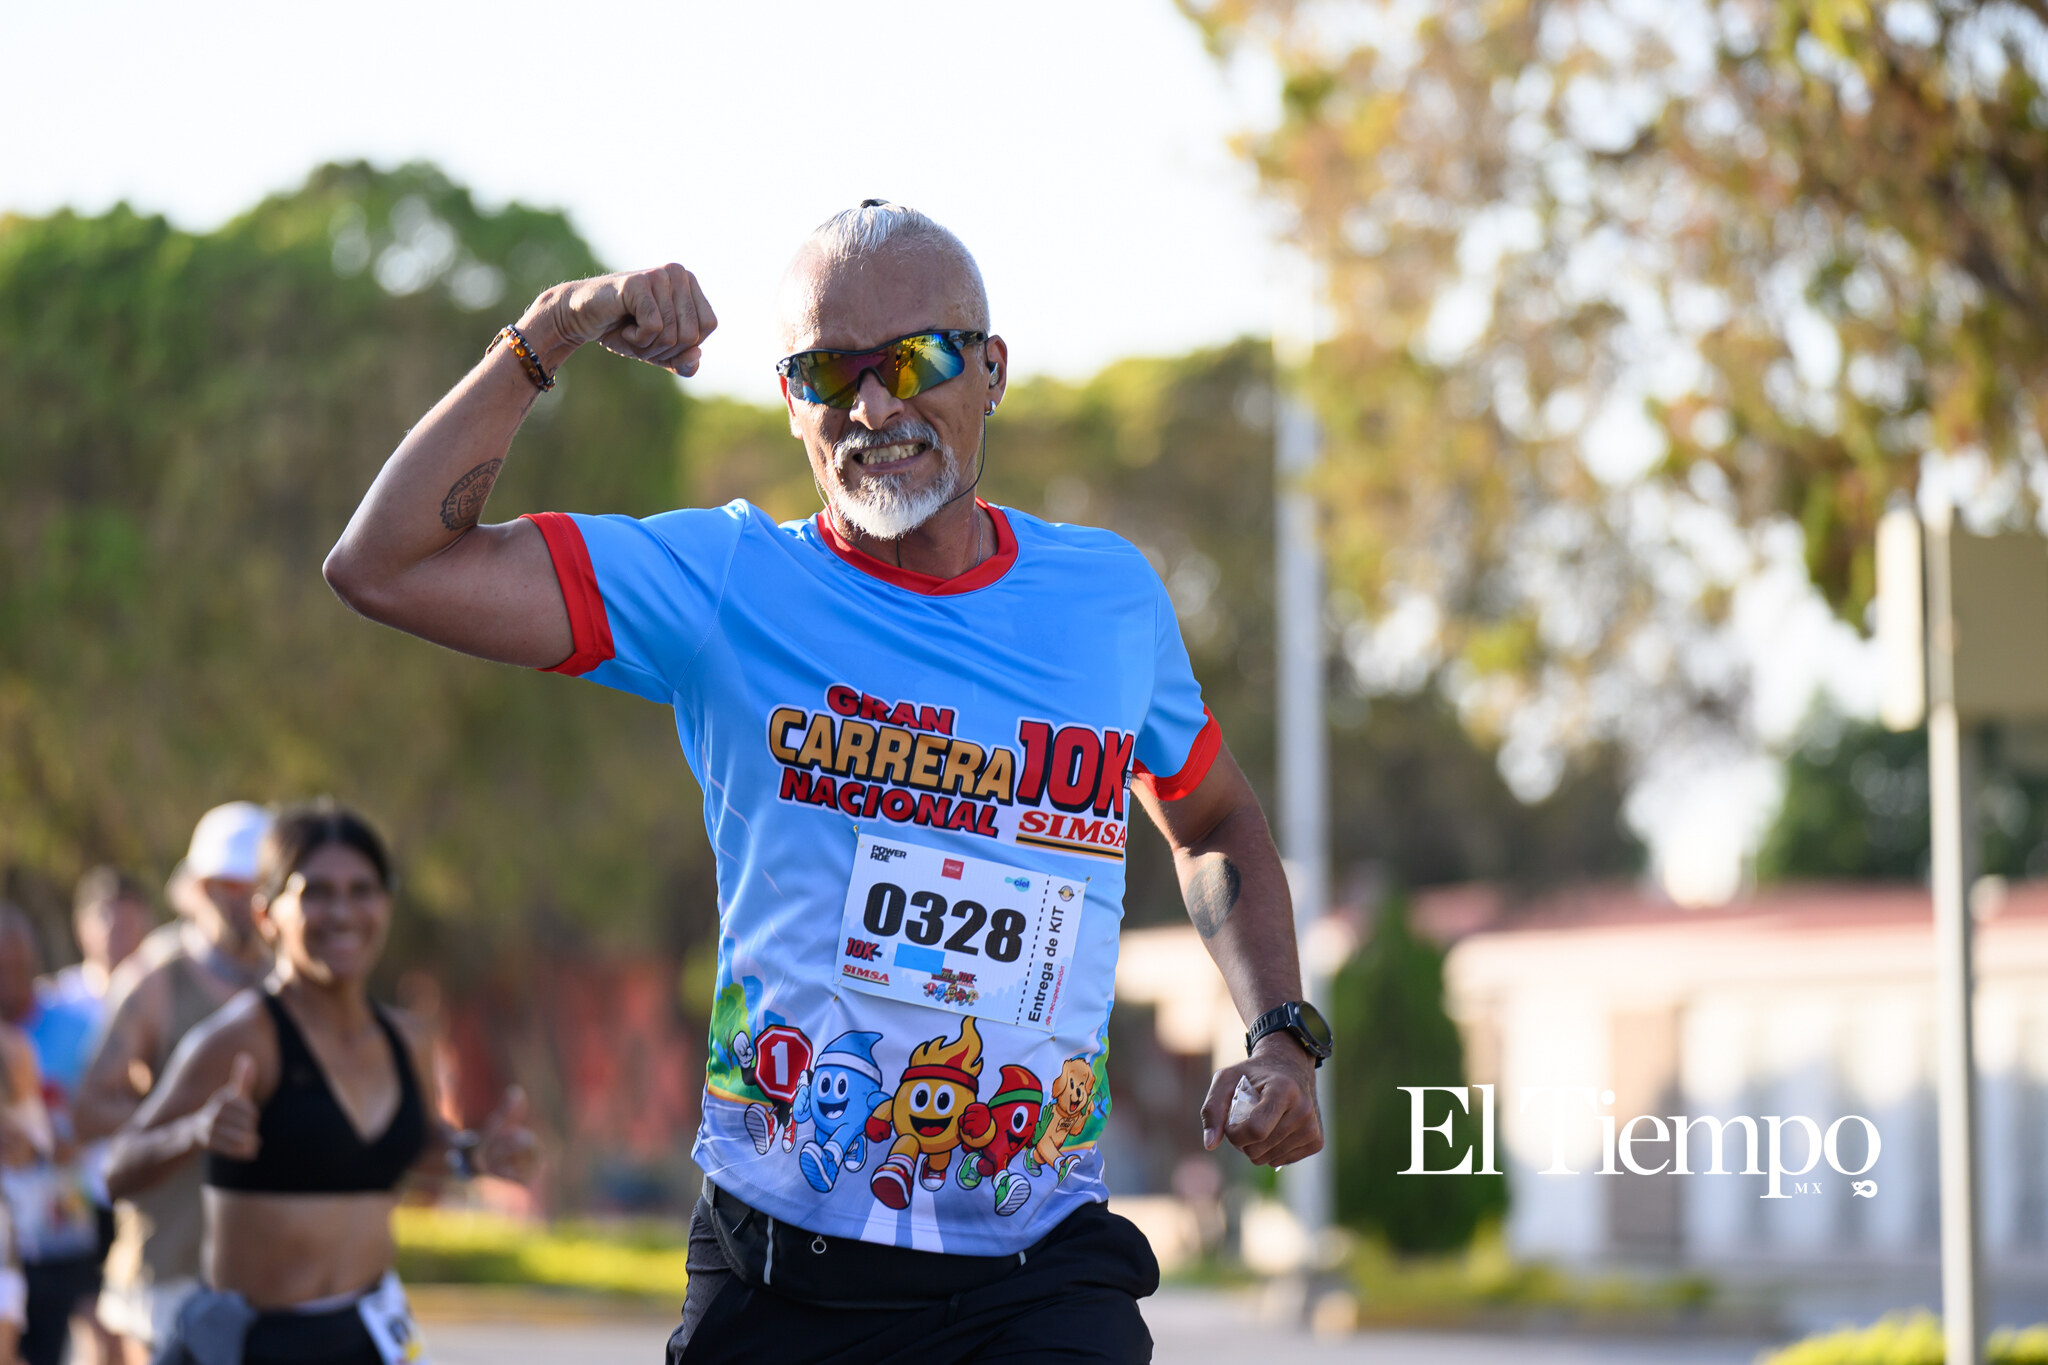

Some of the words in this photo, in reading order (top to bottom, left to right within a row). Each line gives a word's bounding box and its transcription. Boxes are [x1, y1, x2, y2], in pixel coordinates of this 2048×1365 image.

[827, 684, 955, 736] GRAN
[768, 706, 1016, 806] CARRERA
[1015, 719, 1135, 820] 10K
[778, 768, 1000, 838] NACIONAL
[1018, 810, 1127, 848] SIMSA
[871, 844, 908, 859] POWER
[863, 882, 1027, 963] 0328
[1048, 905, 1065, 934] KIT
[845, 937, 883, 962] 10K
[1044, 938, 1058, 957] de
[843, 964, 890, 983] SIMSA
[1027, 962, 1054, 1023] Entrega
[771, 1040, 789, 1087] 1
